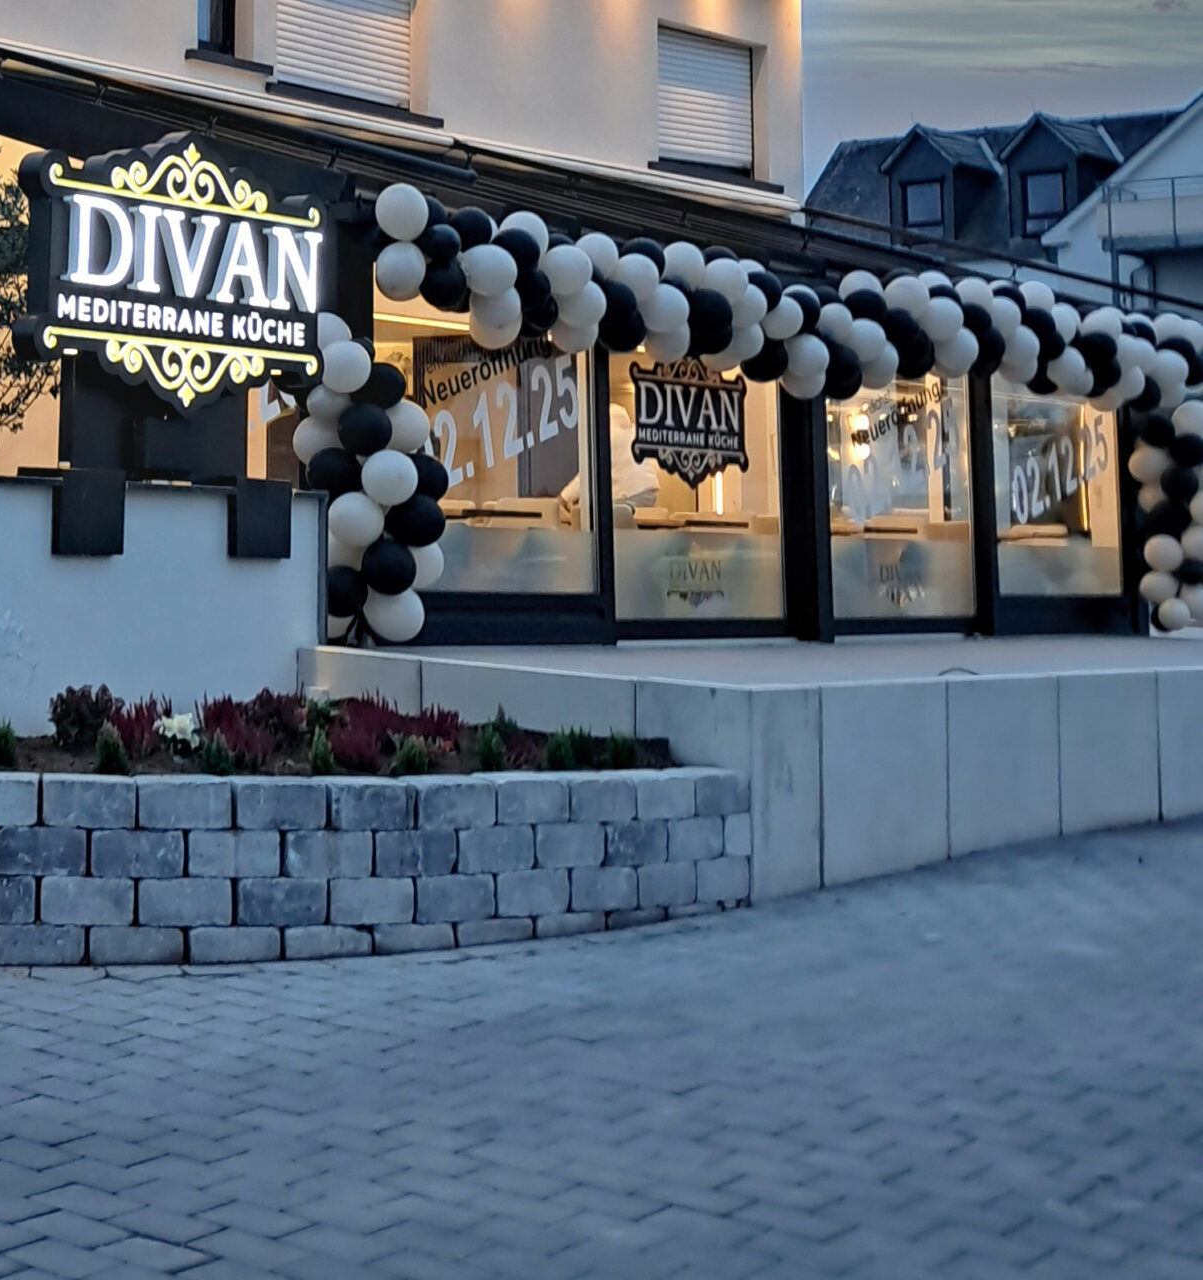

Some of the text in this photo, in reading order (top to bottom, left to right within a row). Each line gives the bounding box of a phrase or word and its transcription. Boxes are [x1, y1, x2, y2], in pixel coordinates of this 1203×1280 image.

[60, 193, 324, 314] DIVAN
[56, 292, 306, 347] MEDITERRANE KÜCHE
[425, 354, 578, 488] 2.12.25
[637, 380, 741, 433] DIVAN
[637, 426, 740, 450] MEDITERRANE KÜCHE
[1012, 414, 1109, 524] 02.12.25
